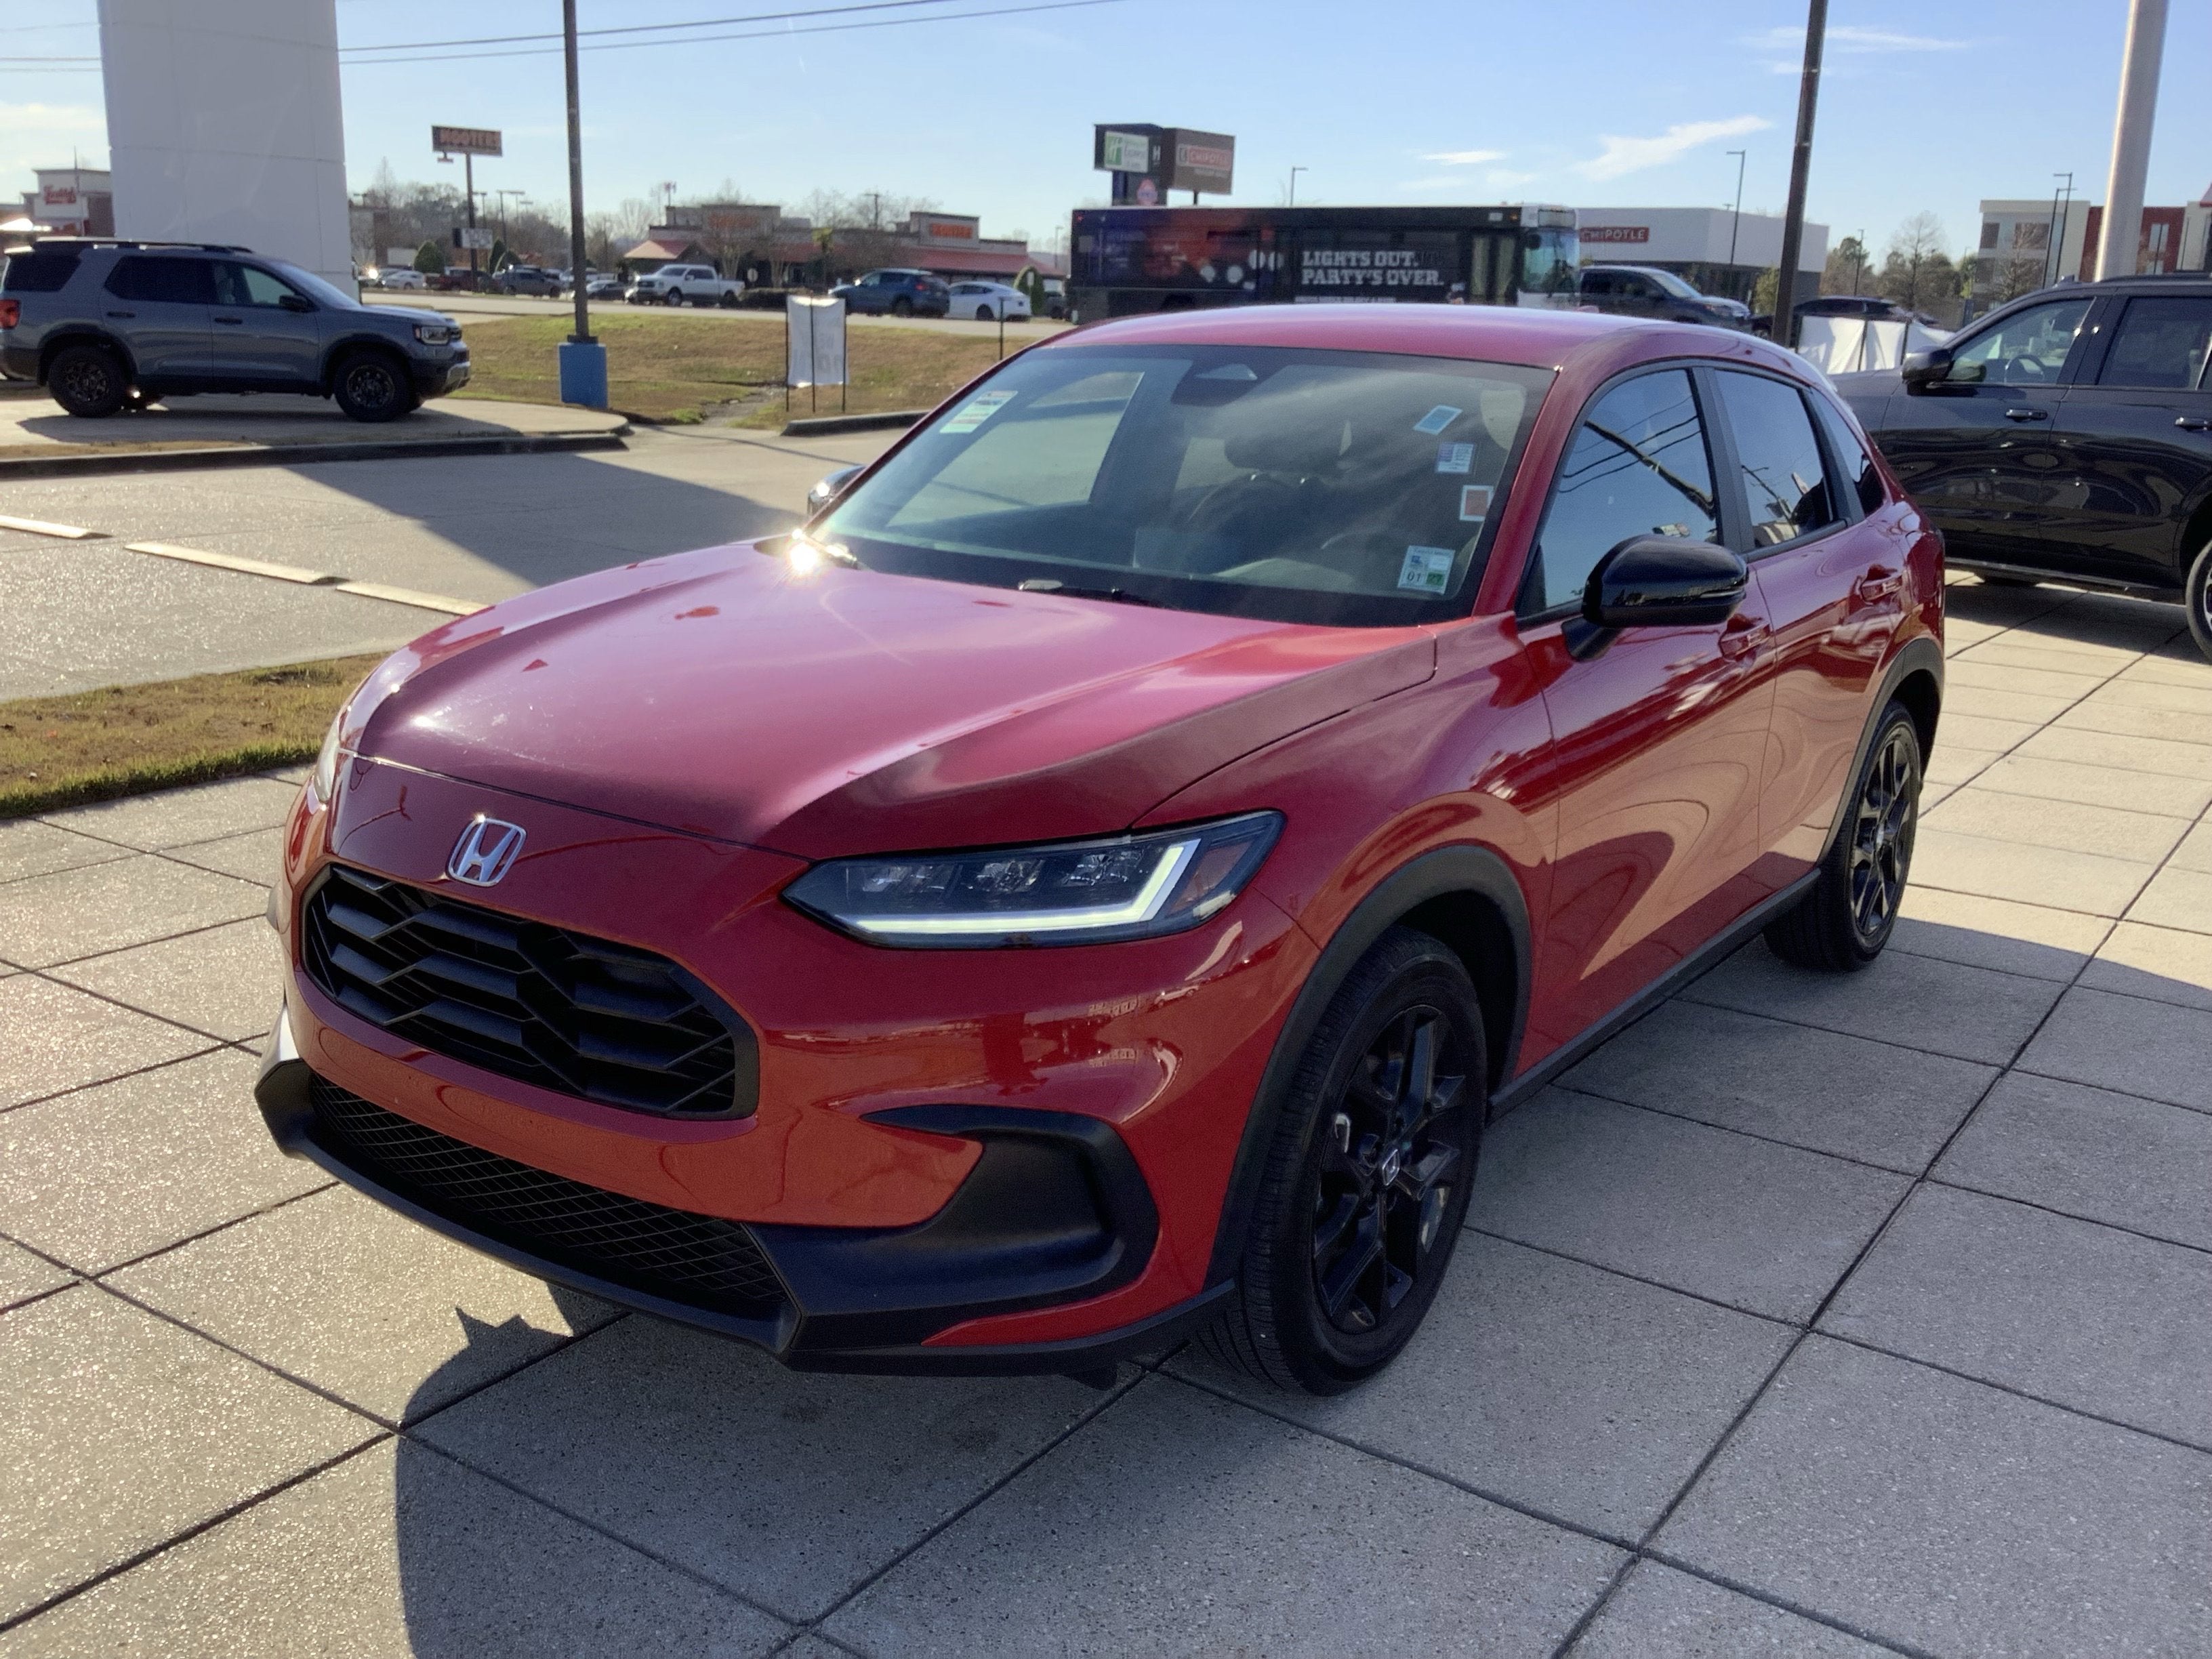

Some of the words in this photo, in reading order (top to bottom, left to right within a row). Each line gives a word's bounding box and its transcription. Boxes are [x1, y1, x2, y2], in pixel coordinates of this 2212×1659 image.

[1303, 251, 1370, 266] LIGHTS
[1374, 251, 1418, 267] OUT.
[1301, 269, 1382, 285] PARTY'S
[1387, 270, 1445, 285] OVER.
[1407, 571, 1421, 582] 01
